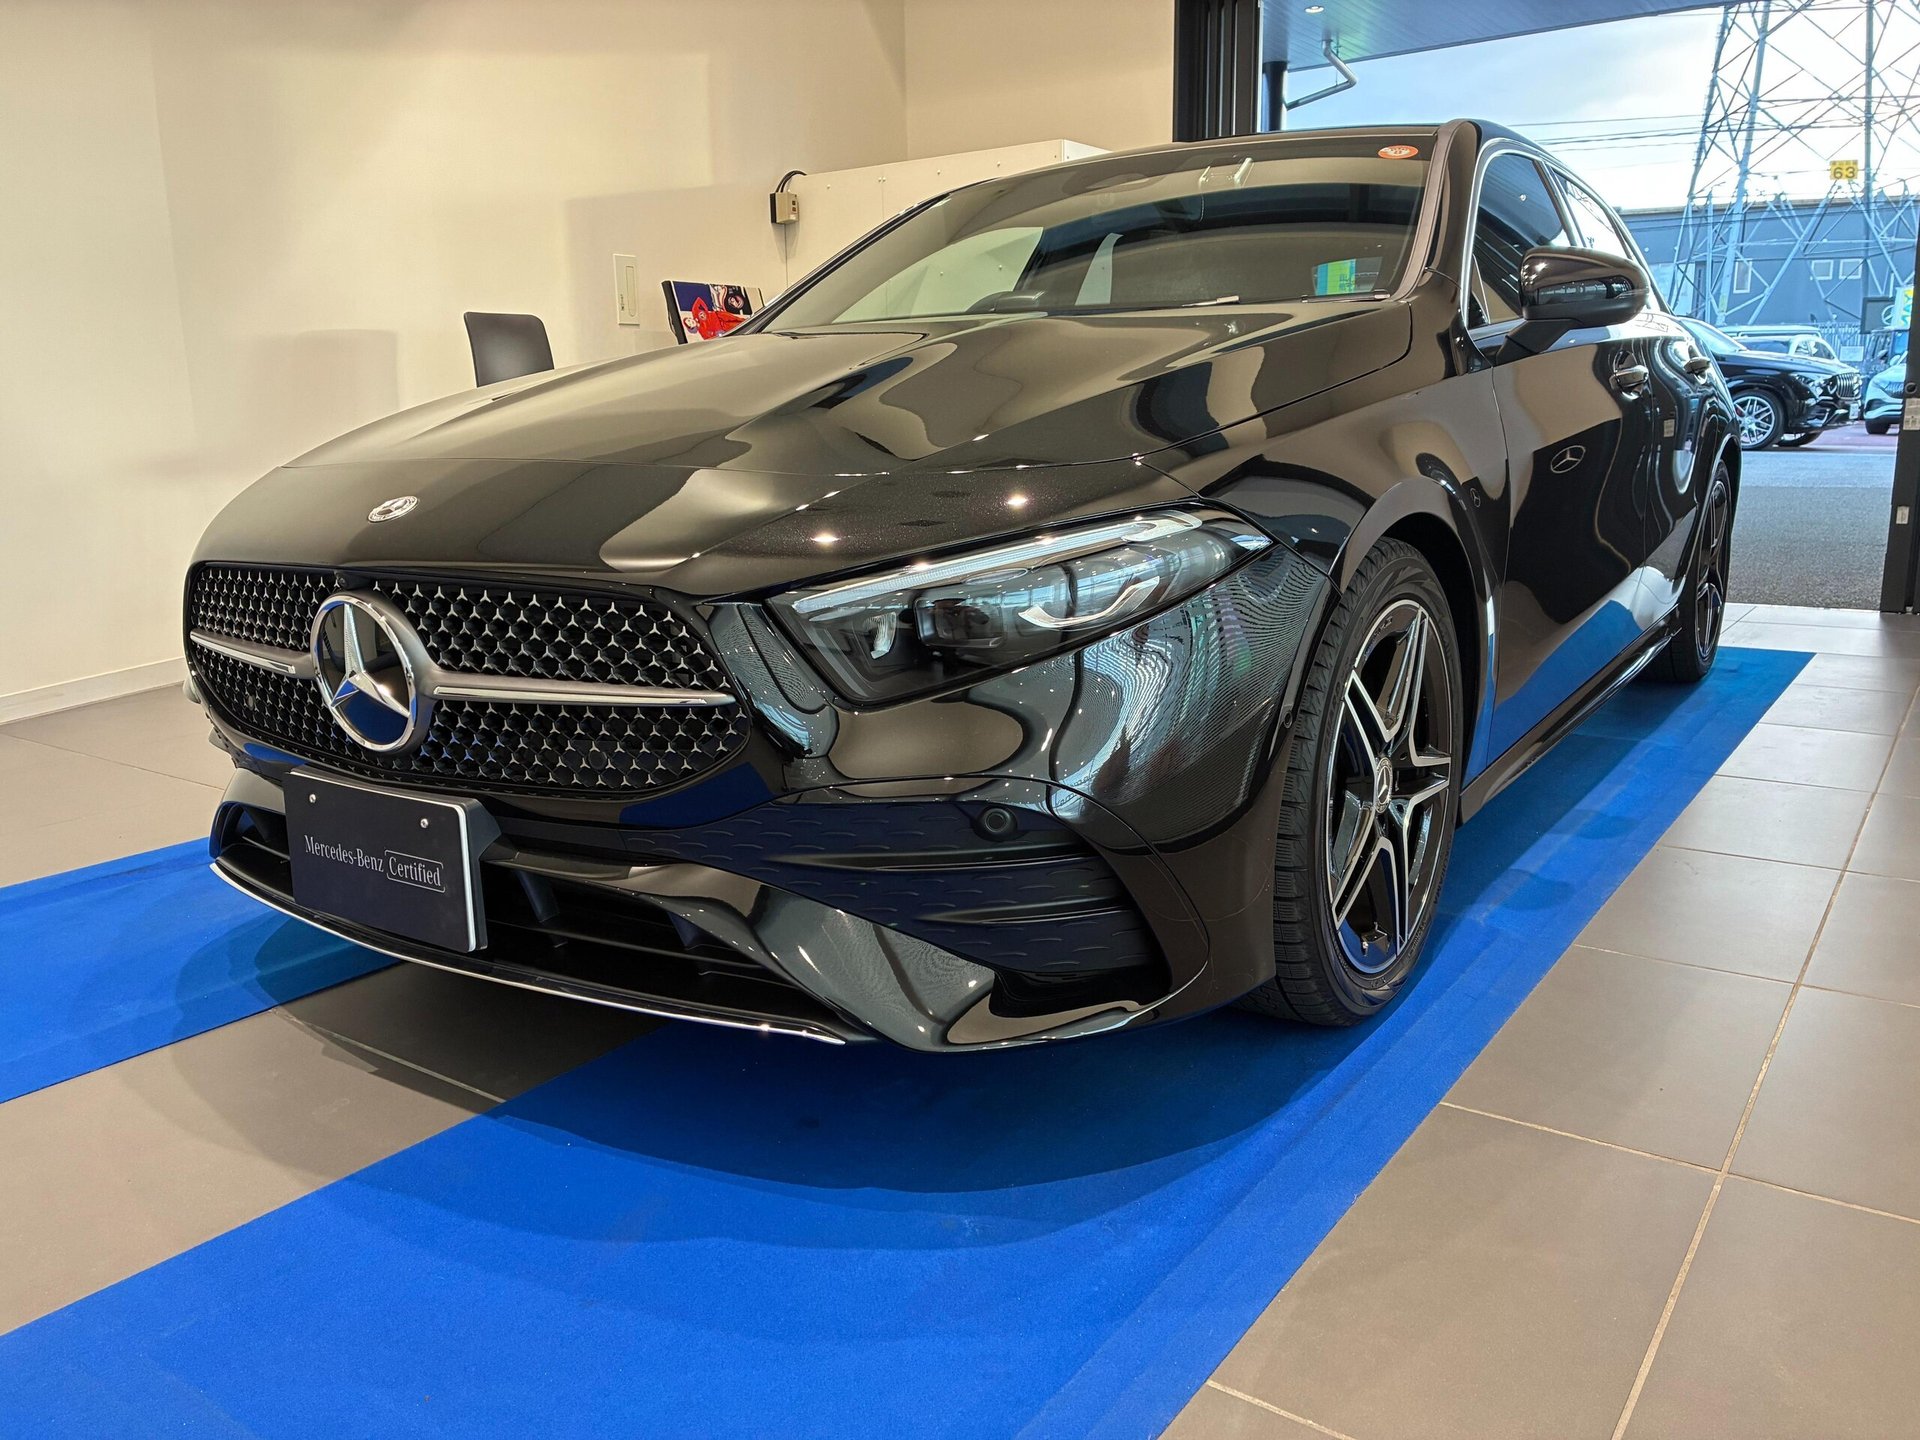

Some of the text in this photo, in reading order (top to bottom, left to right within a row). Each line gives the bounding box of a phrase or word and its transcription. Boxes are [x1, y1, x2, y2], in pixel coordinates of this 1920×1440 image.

[1833, 166, 1855, 179] 63
[304, 834, 442, 887] Mercedes-Benz Certified
